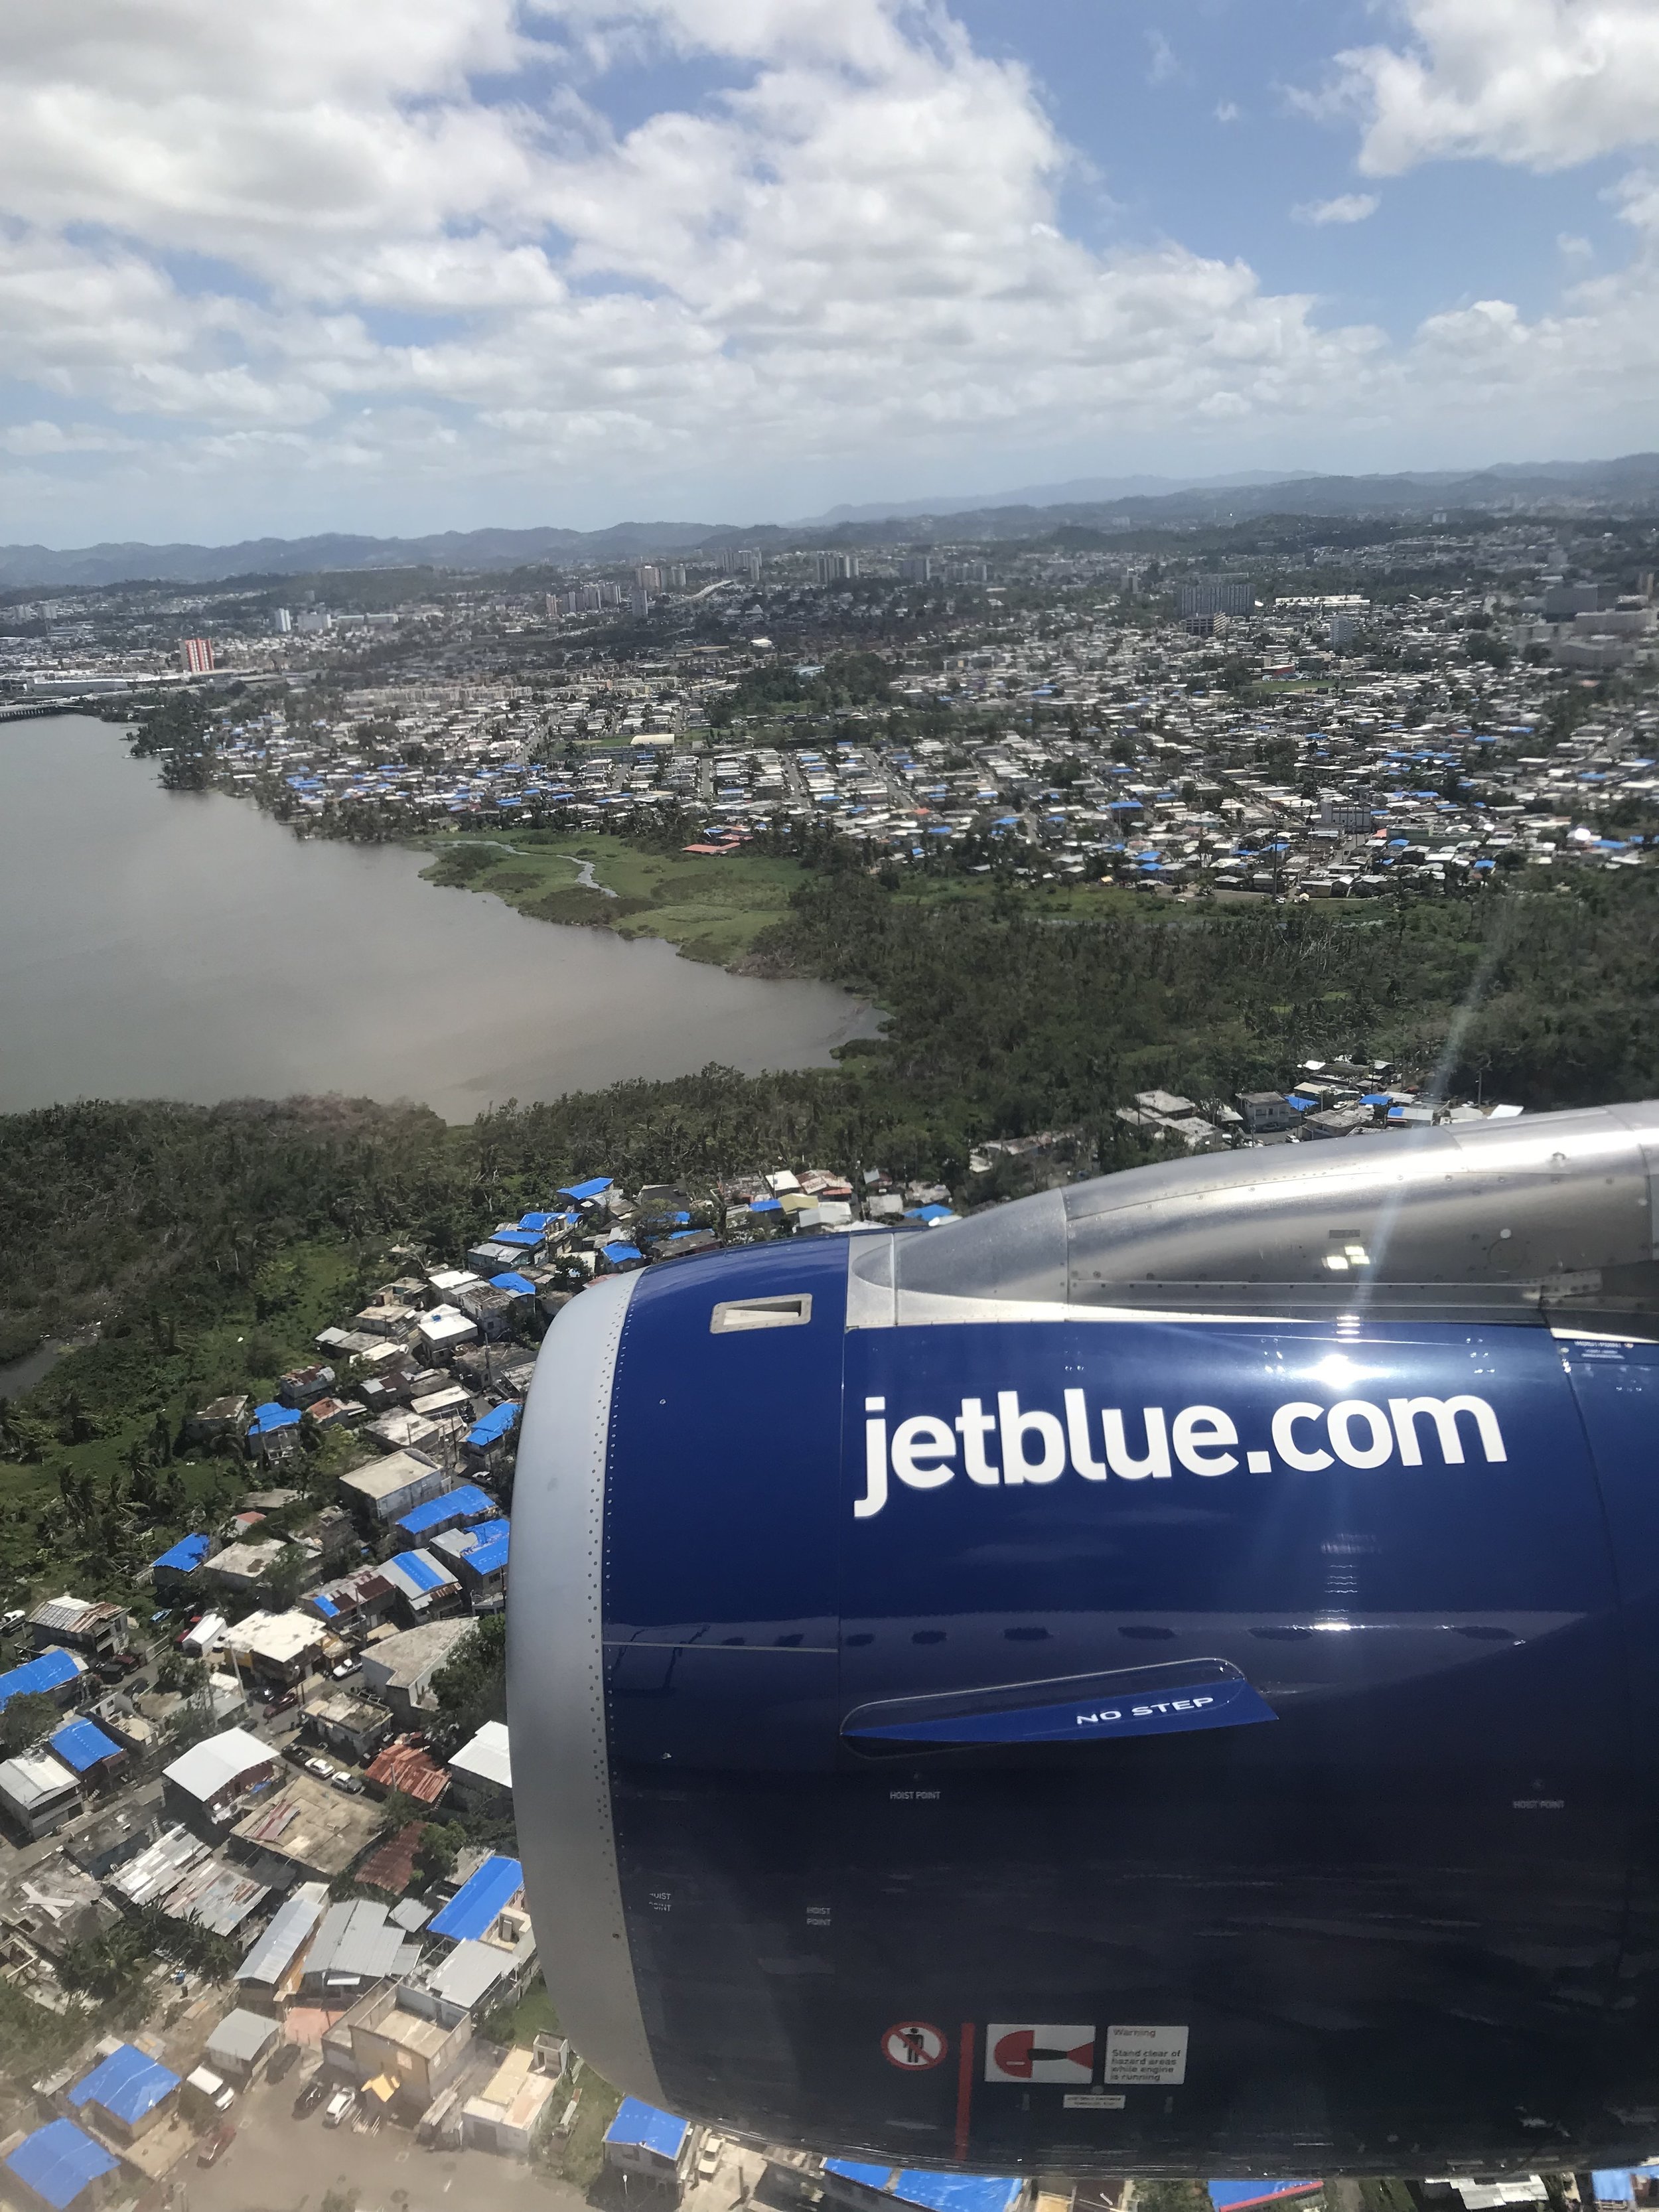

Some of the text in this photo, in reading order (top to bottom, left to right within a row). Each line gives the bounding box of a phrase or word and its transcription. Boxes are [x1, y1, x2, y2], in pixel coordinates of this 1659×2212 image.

[854, 1388, 1508, 1517] jetblue.com
[1076, 1697, 1214, 1725] NO STEP
[1113, 2028, 1156, 2038] Warning
[1112, 2049, 1141, 2057] Stand
